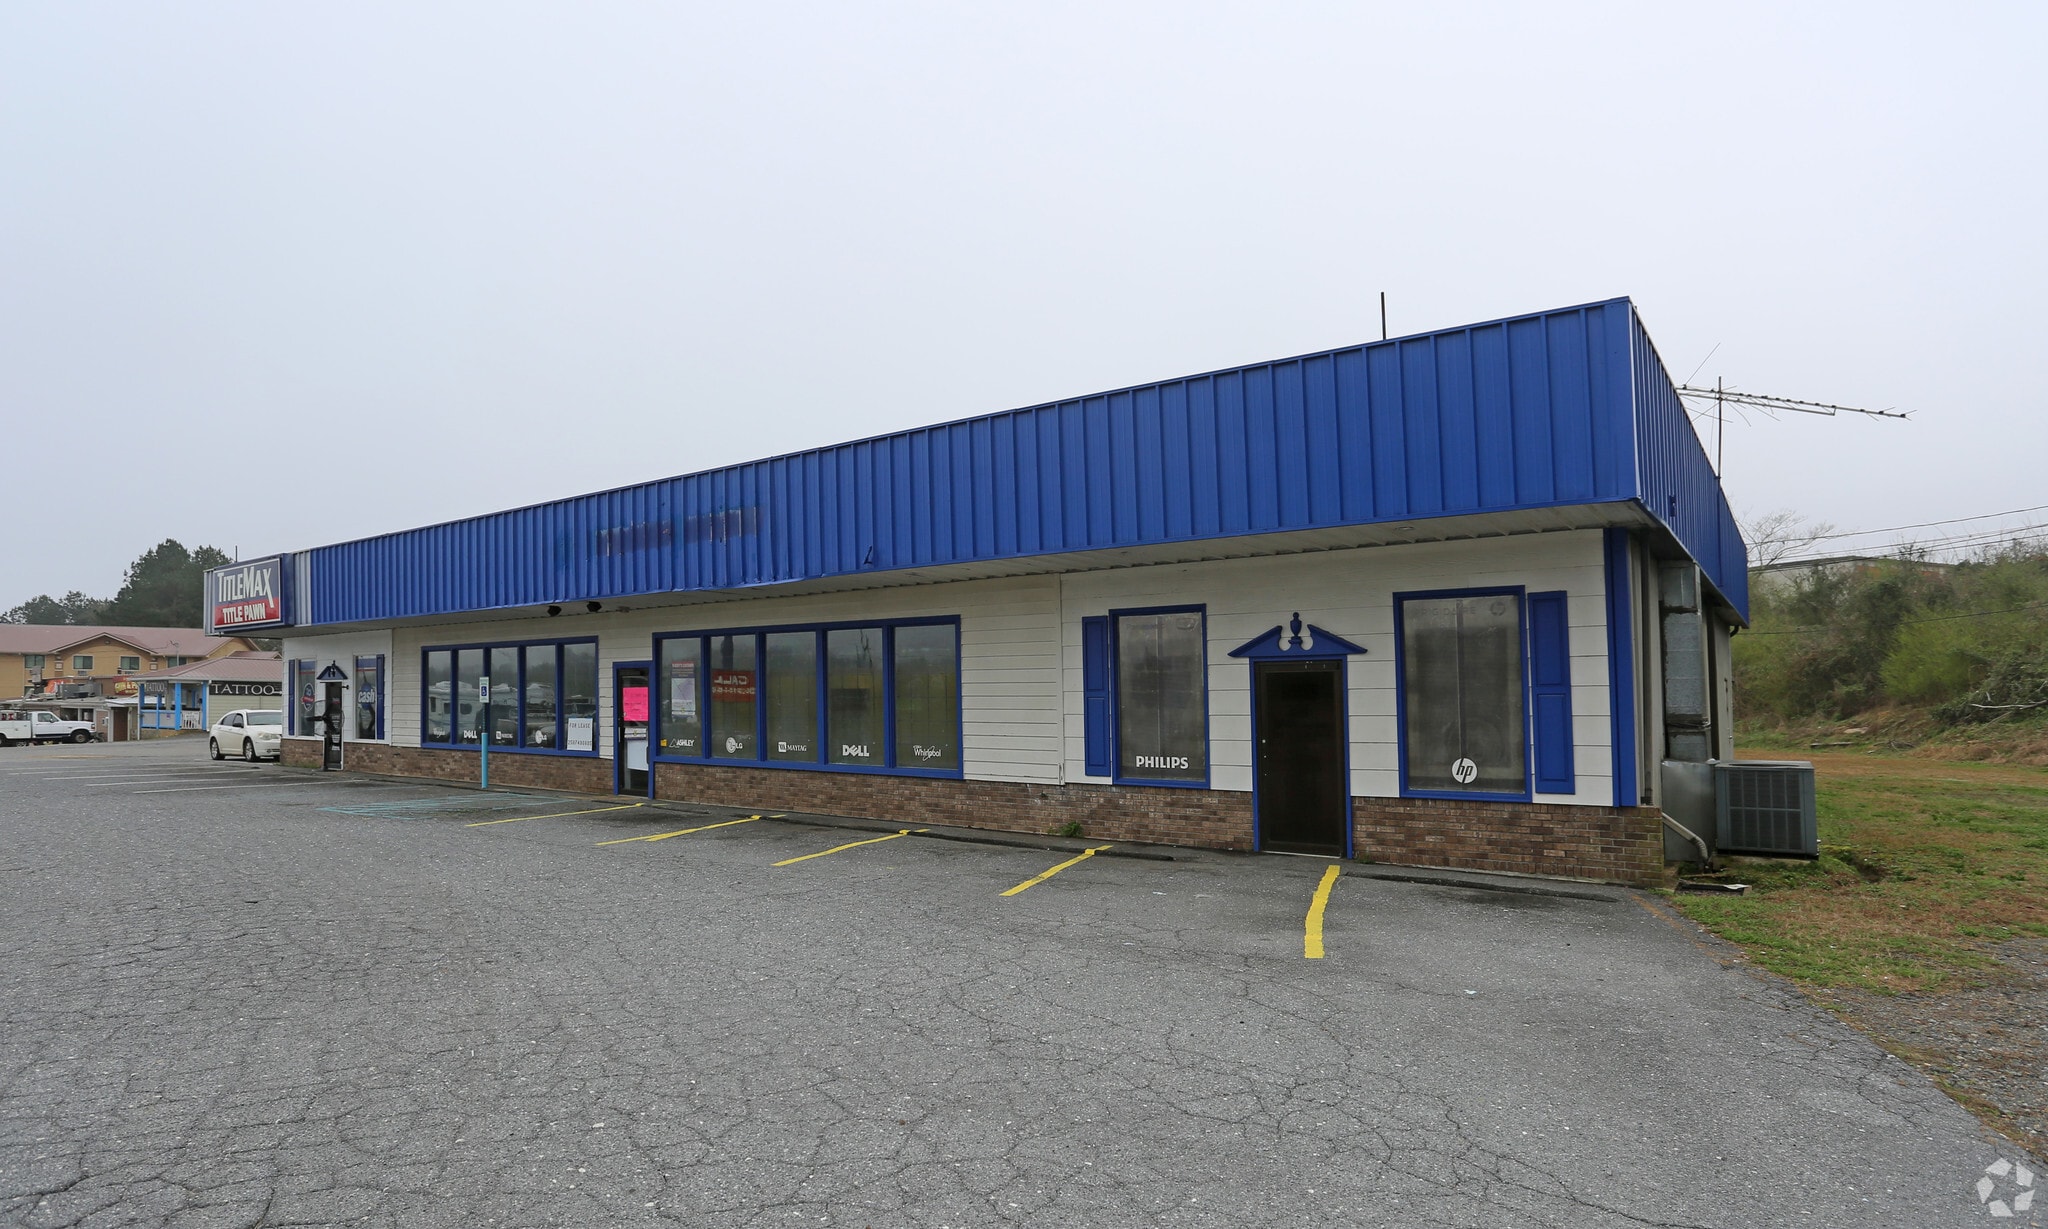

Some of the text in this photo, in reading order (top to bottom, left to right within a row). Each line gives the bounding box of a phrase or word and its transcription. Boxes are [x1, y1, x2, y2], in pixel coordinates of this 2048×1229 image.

[222, 603, 266, 623] TITLE PAWN
[144, 683, 165, 691] TATTOO
[211, 684, 275, 695] TATTOO
[358, 689, 375, 703] cash
[463, 730, 478, 739] DELL
[787, 744, 807, 752] MAYTAG
[842, 744, 870, 757] DELL
[913, 745, 942, 761] Whirlpool
[1135, 755, 1189, 770] PHILIPS
[1454, 757, 1476, 784] hp
